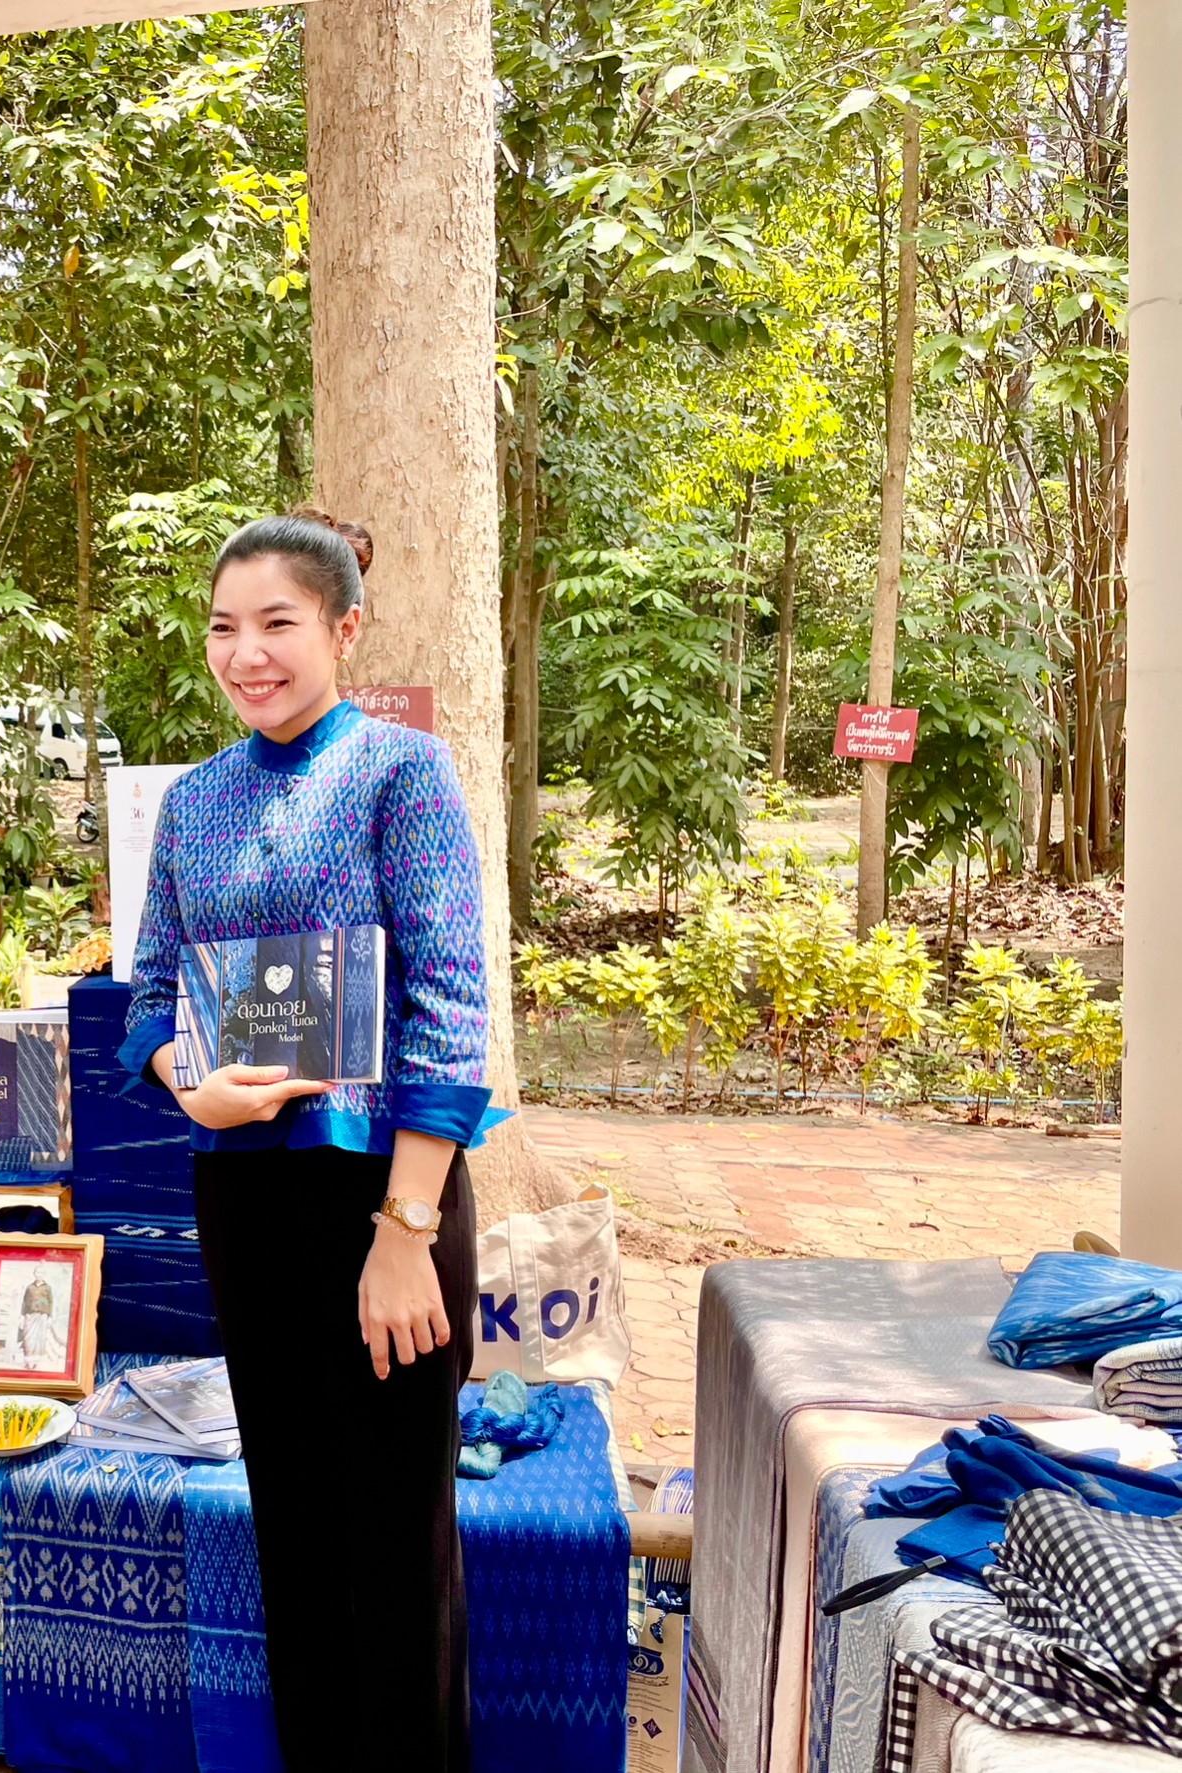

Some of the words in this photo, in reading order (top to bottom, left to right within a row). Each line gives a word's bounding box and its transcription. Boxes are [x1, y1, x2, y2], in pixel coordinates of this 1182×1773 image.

[237, 1000, 306, 1019] ดอนกอย
[249, 1020, 288, 1035] Donkoi
[291, 1014, 318, 1027] โมเดล
[278, 1033, 303, 1043] Model
